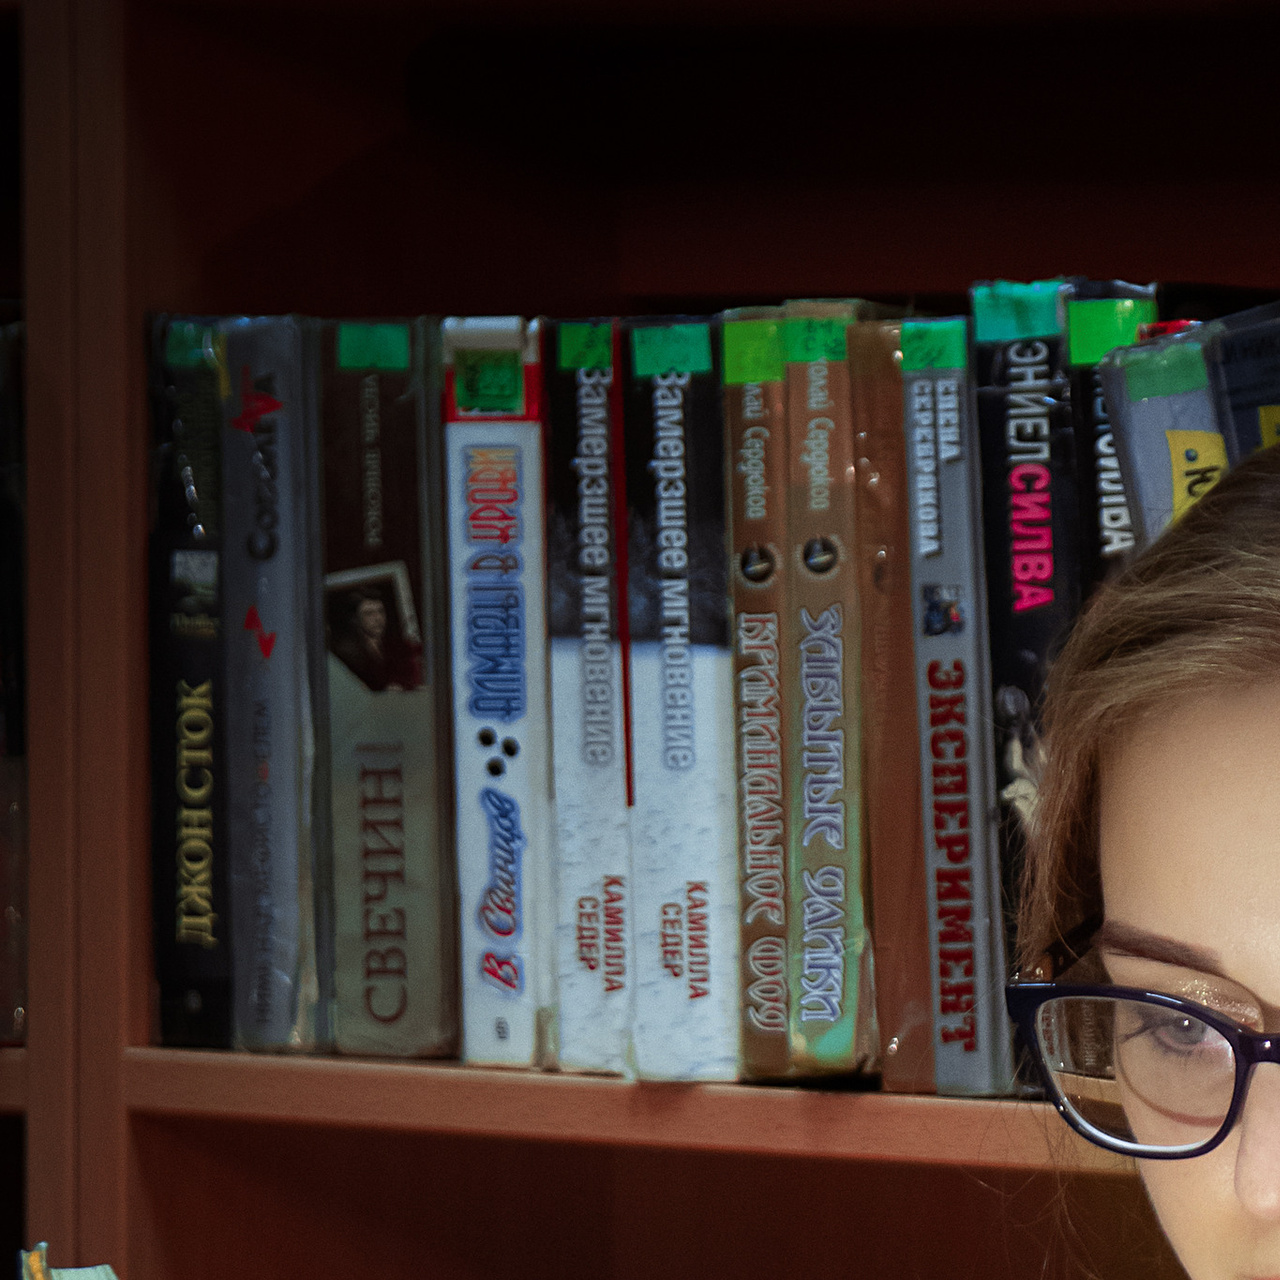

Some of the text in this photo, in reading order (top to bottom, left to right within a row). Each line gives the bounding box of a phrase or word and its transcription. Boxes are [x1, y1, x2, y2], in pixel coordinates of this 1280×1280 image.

[737, 426, 770, 519] Сердюков
[799, 416, 835, 510] Сердюков
[913, 379, 941, 557] СЕРЕБРЯКОВА
[937, 379, 962, 460] ЕЛЕНА
[570, 365, 618, 762] Замерзшее мгновение
[647, 370, 697, 772] Замерзшее мгновение
[177, 680, 214, 800] СТОК
[740, 610, 787, 926] КРИМИНАЛЬНОЕ
[800, 604, 846, 850] ЗАБЫТЫЕ
[177, 806, 217, 944] ДЖОН
[359, 764, 408, 1025] СВЕЧИН
[478, 787, 524, 937] Свинцов
[928, 659, 980, 1054] ЭКСПЕРИМЕНТ
[577, 896, 600, 970] СЕДЕР
[603, 875, 627, 993] КАМИЛЛА
[660, 902, 684, 977] СЕДЕР
[685, 880, 710, 999] КАМИЛЛА
